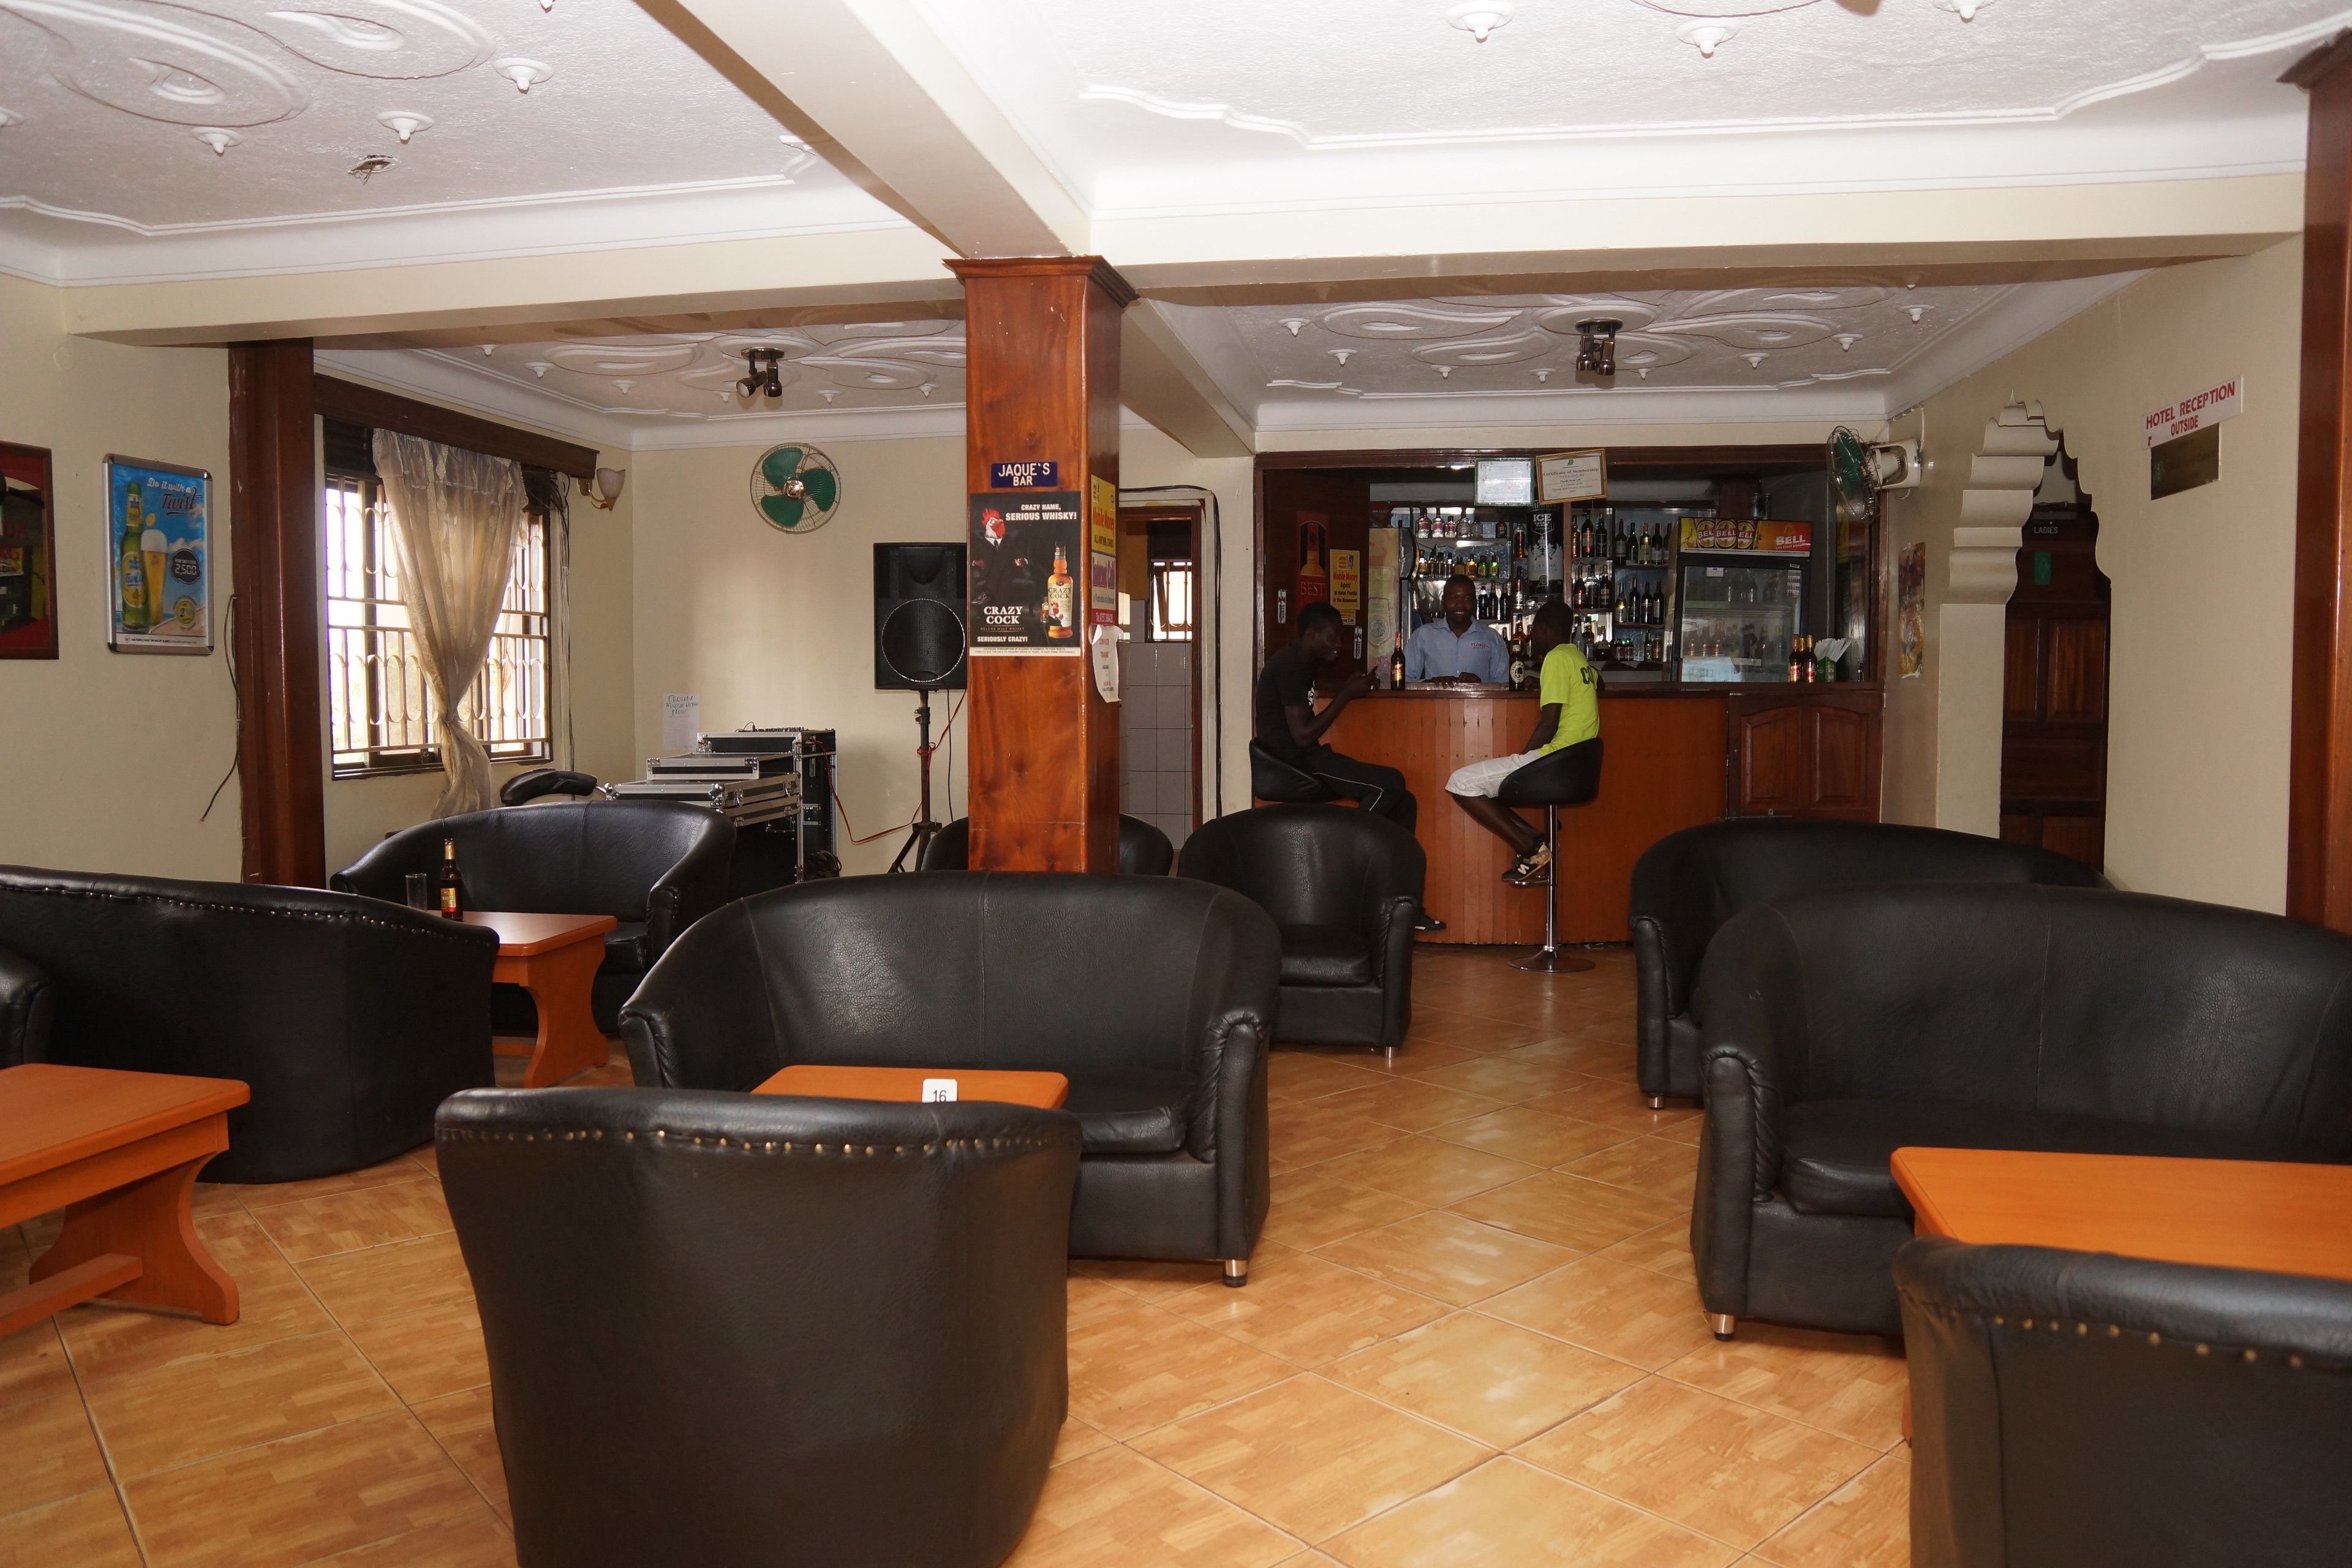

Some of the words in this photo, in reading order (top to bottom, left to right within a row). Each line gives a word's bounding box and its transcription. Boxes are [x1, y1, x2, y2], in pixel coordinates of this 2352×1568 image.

[2146, 406, 2176, 429] HOTEL
[2179, 380, 2235, 417] RECEPTION
[2171, 415, 2199, 436] OUTSIDE
[998, 462, 1050, 477] JAQUE'S
[147, 477, 160, 488] Do
[161, 481, 168, 489] it
[168, 481, 184, 492] with
[1012, 476, 1033, 486] BAR
[162, 487, 201, 509] Twist
[1005, 512, 1040, 521] SERIOUS
[1042, 511, 1077, 520] WHISKY!
[1533, 513, 1552, 522] ICE
[1776, 535, 1806, 545] BELL
[1333, 571, 1346, 581] Mobile
[1346, 571, 1358, 582] Money
[1300, 582, 1325, 596] BEST
[984, 606, 1023, 614] CRAZY
[986, 616, 1020, 624] COCK
[933, 1090, 947, 1102] 16
